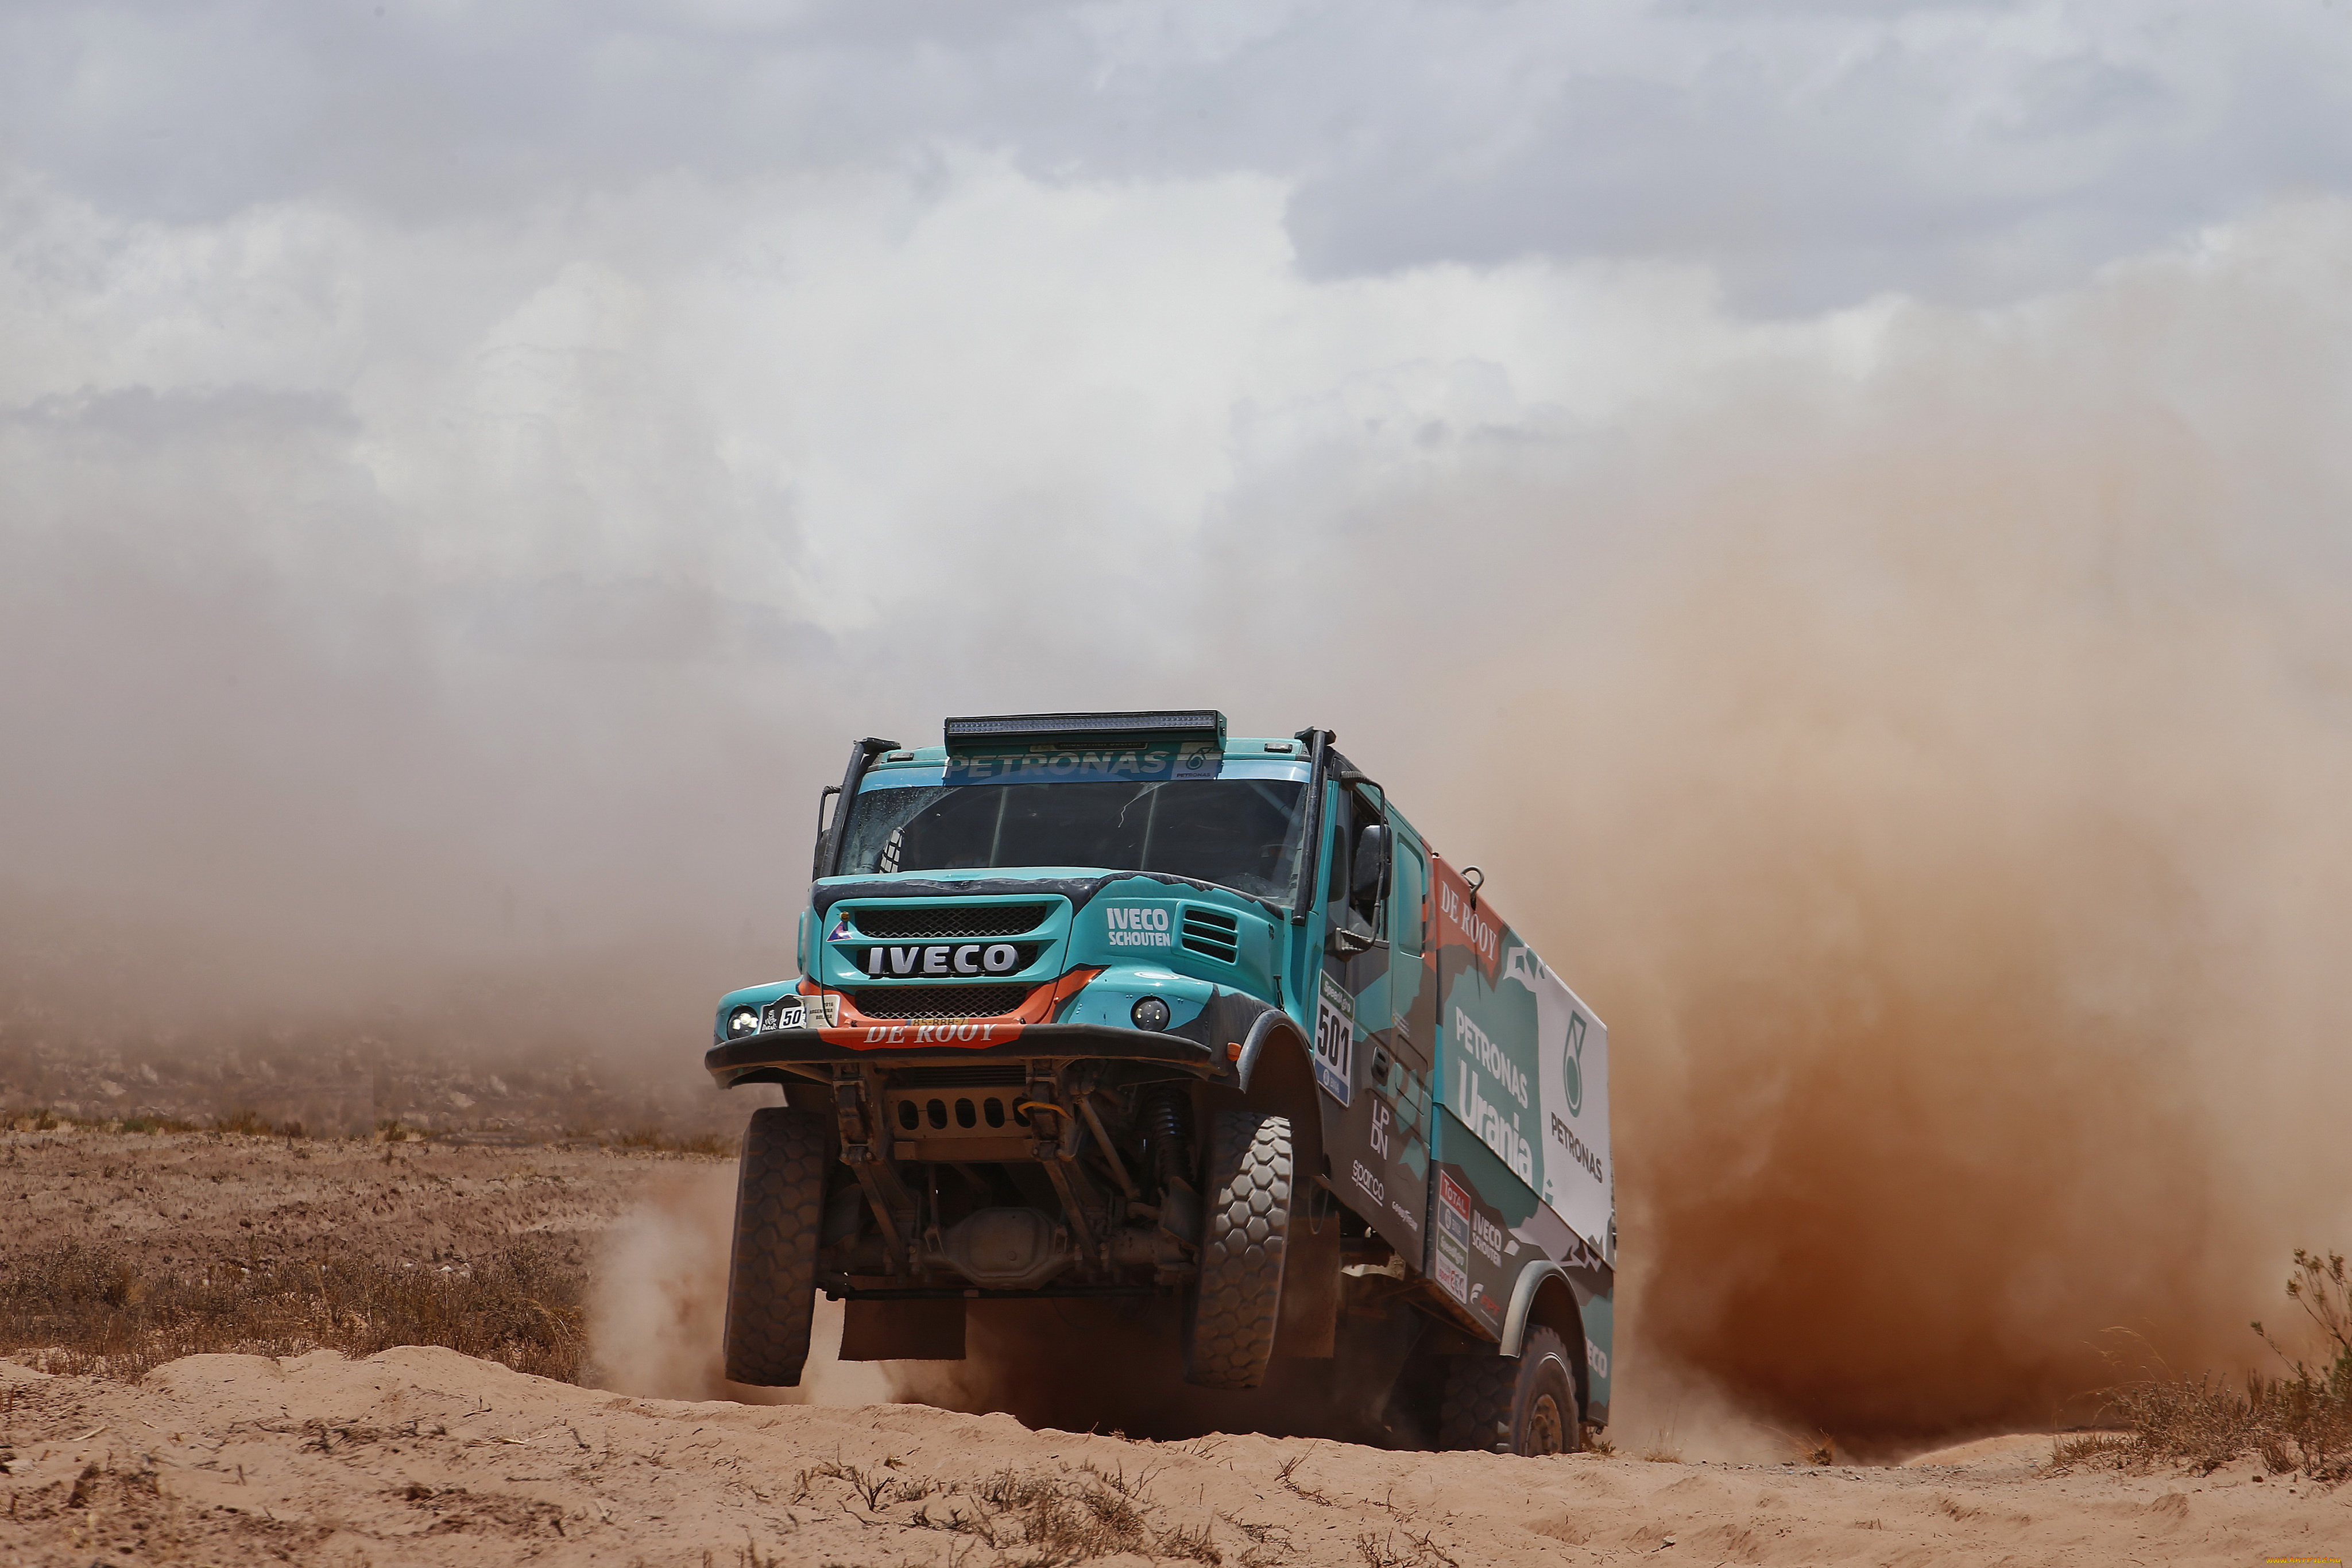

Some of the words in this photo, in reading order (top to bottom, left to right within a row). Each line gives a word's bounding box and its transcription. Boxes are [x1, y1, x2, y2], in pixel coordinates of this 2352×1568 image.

[945, 751, 1170, 778] PETRONAS
[1107, 908, 1169, 931] IVECO
[1108, 932, 1171, 946] SCHOUTEN
[1441, 881, 1459, 923] DE
[1461, 902, 1496, 961] ROOY
[868, 944, 1015, 974] IVECO
[864, 1025, 908, 1043] DE
[914, 1024, 998, 1043] ROOY
[1318, 1004, 1349, 1077] 501
[1456, 1006, 1527, 1109] PETRONAS
[1459, 1059, 1533, 1188] Urania
[1551, 1112, 1602, 1183] PETRONAS
[1353, 1159, 1384, 1201] sparco
[1444, 1179, 1467, 1214] TOTAL
[1472, 1232, 1502, 1268] SCHOUTEN
[1473, 1209, 1502, 1252] IVECO
[1585, 1336, 1607, 1379] ECO
